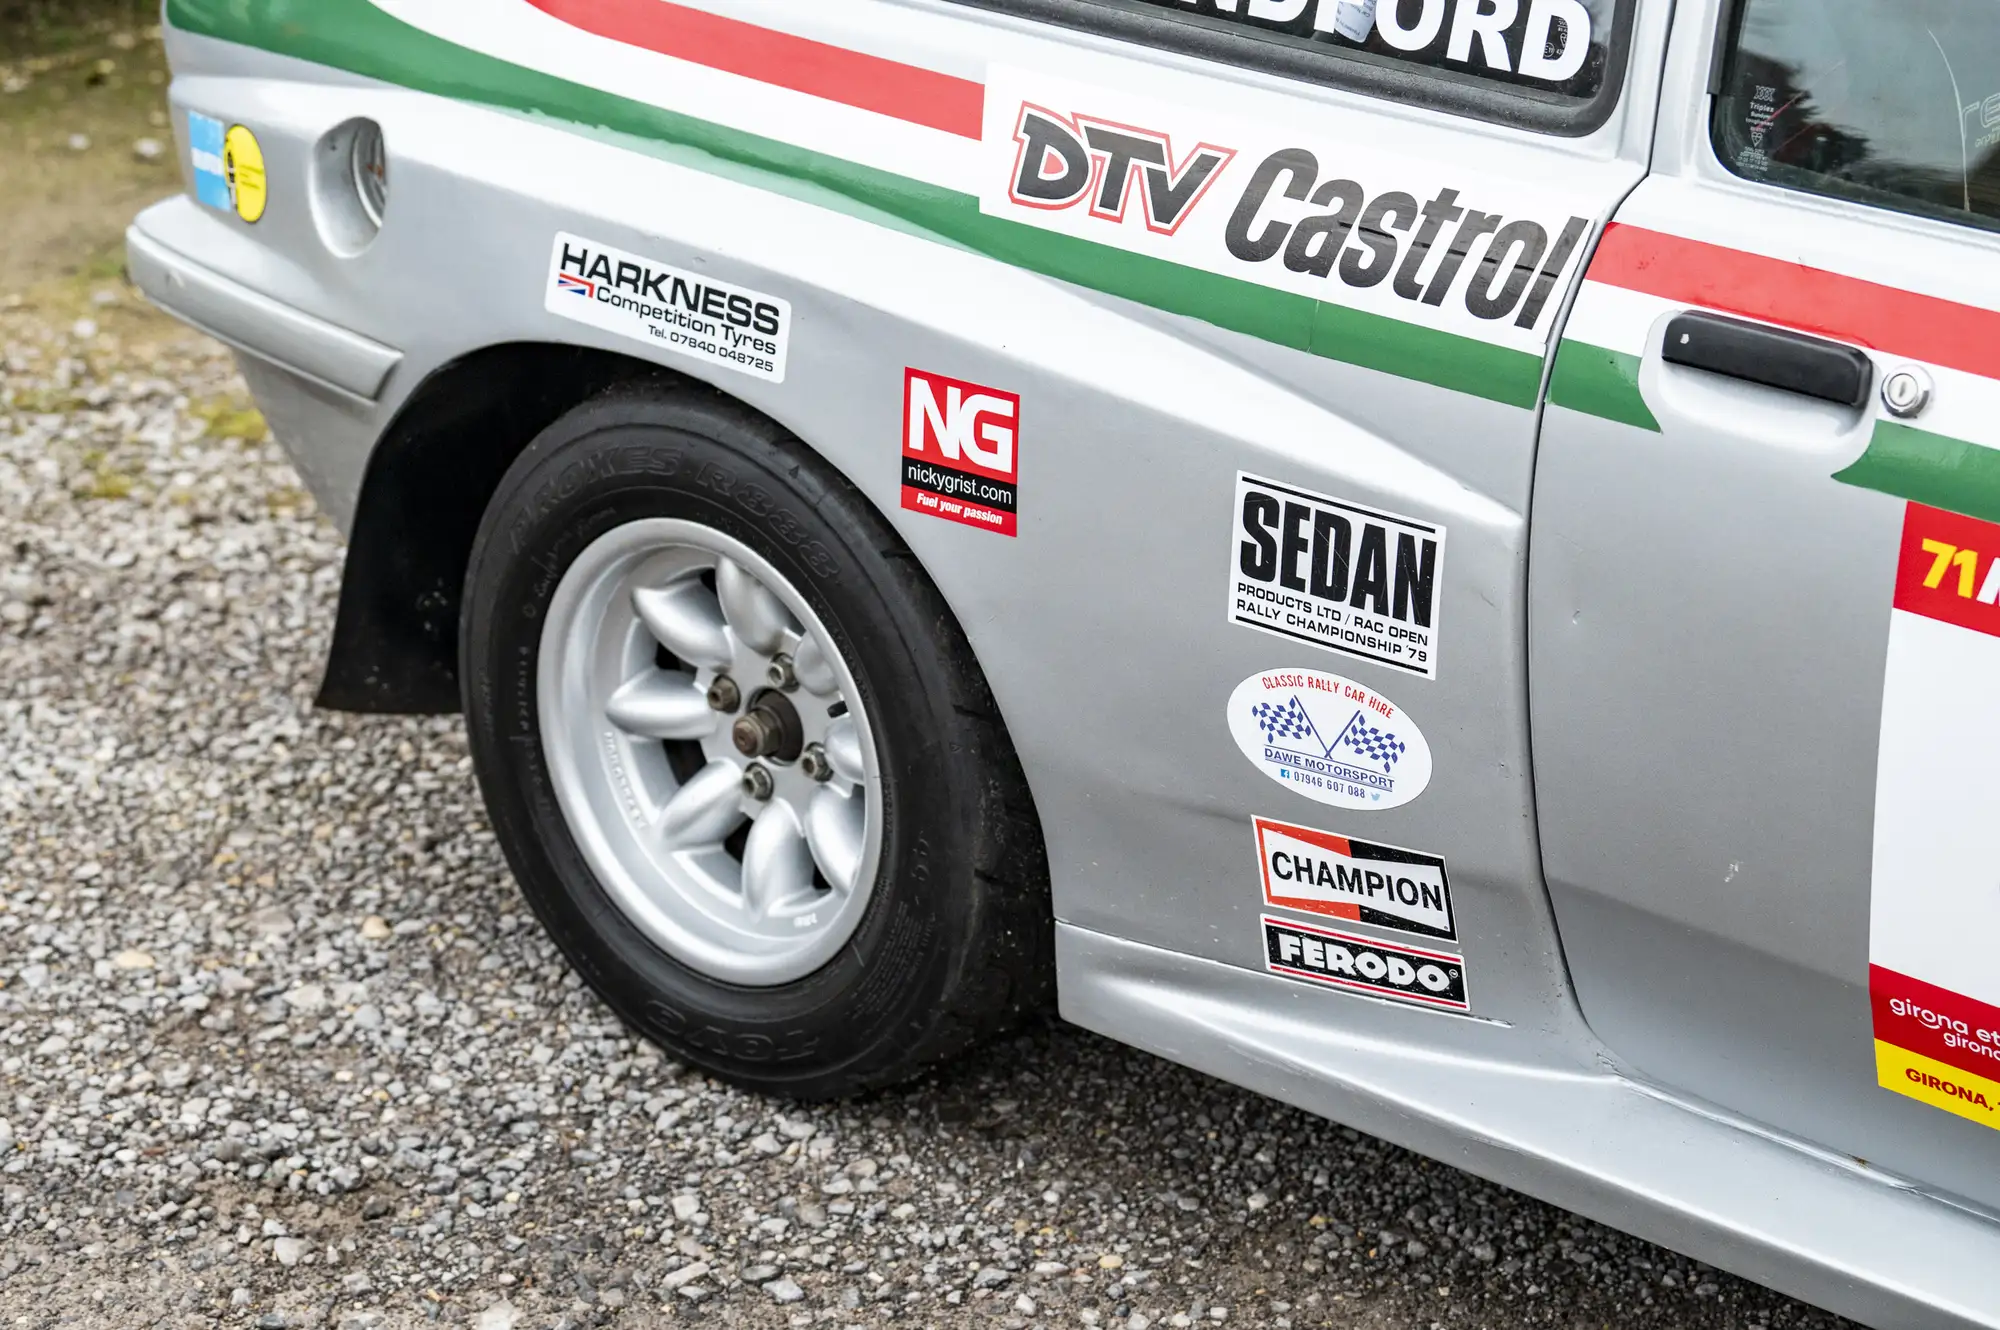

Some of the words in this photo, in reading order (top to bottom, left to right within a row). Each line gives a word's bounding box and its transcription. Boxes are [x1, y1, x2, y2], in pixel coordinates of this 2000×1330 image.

[1010, 102, 1236, 234] DTV
[1224, 147, 1589, 330] Castrol
[560, 243, 780, 336] HARKNESS
[596, 286, 716, 337] Competition
[720, 323, 777, 355] Tyres
[648, 324, 667, 340] Tel.
[670, 331, 716, 354] 07840
[718, 346, 774, 372] 048725
[908, 376, 1014, 474] NG
[908, 464, 1012, 505] nickygrist.com
[916, 492, 938, 508] Fuel
[939, 499, 963, 514] your
[963, 506, 1003, 525] passion
[1239, 491, 1438, 628] SEDAN
[1236, 598, 1281, 620] RALLY
[1286, 613, 1402, 655] CHAMPIONSHIP
[1237, 582, 1313, 614] PRODUCTS
[1316, 604, 1342, 623] LTD
[1353, 615, 1384, 634] RAC
[1388, 625, 1429, 646] OPEN
[1261, 674, 1304, 690] CLASSIC
[1308, 676, 1340, 694] RALLY
[1344, 685, 1366, 704] CAR
[1368, 696, 1395, 719] HIRE
[1264, 748, 1301, 765] DAWE
[1304, 758, 1395, 789] MOTORSPORT
[1293, 771, 1323, 788] 07946
[1326, 779, 1344, 793] 607
[1347, 784, 1365, 799] 088
[1271, 851, 1443, 912] CHAMPION
[1277, 932, 1451, 992] FERODO
[1889, 998, 1968, 1035] girona
[1905, 1068, 1994, 1112] GIRONA,
